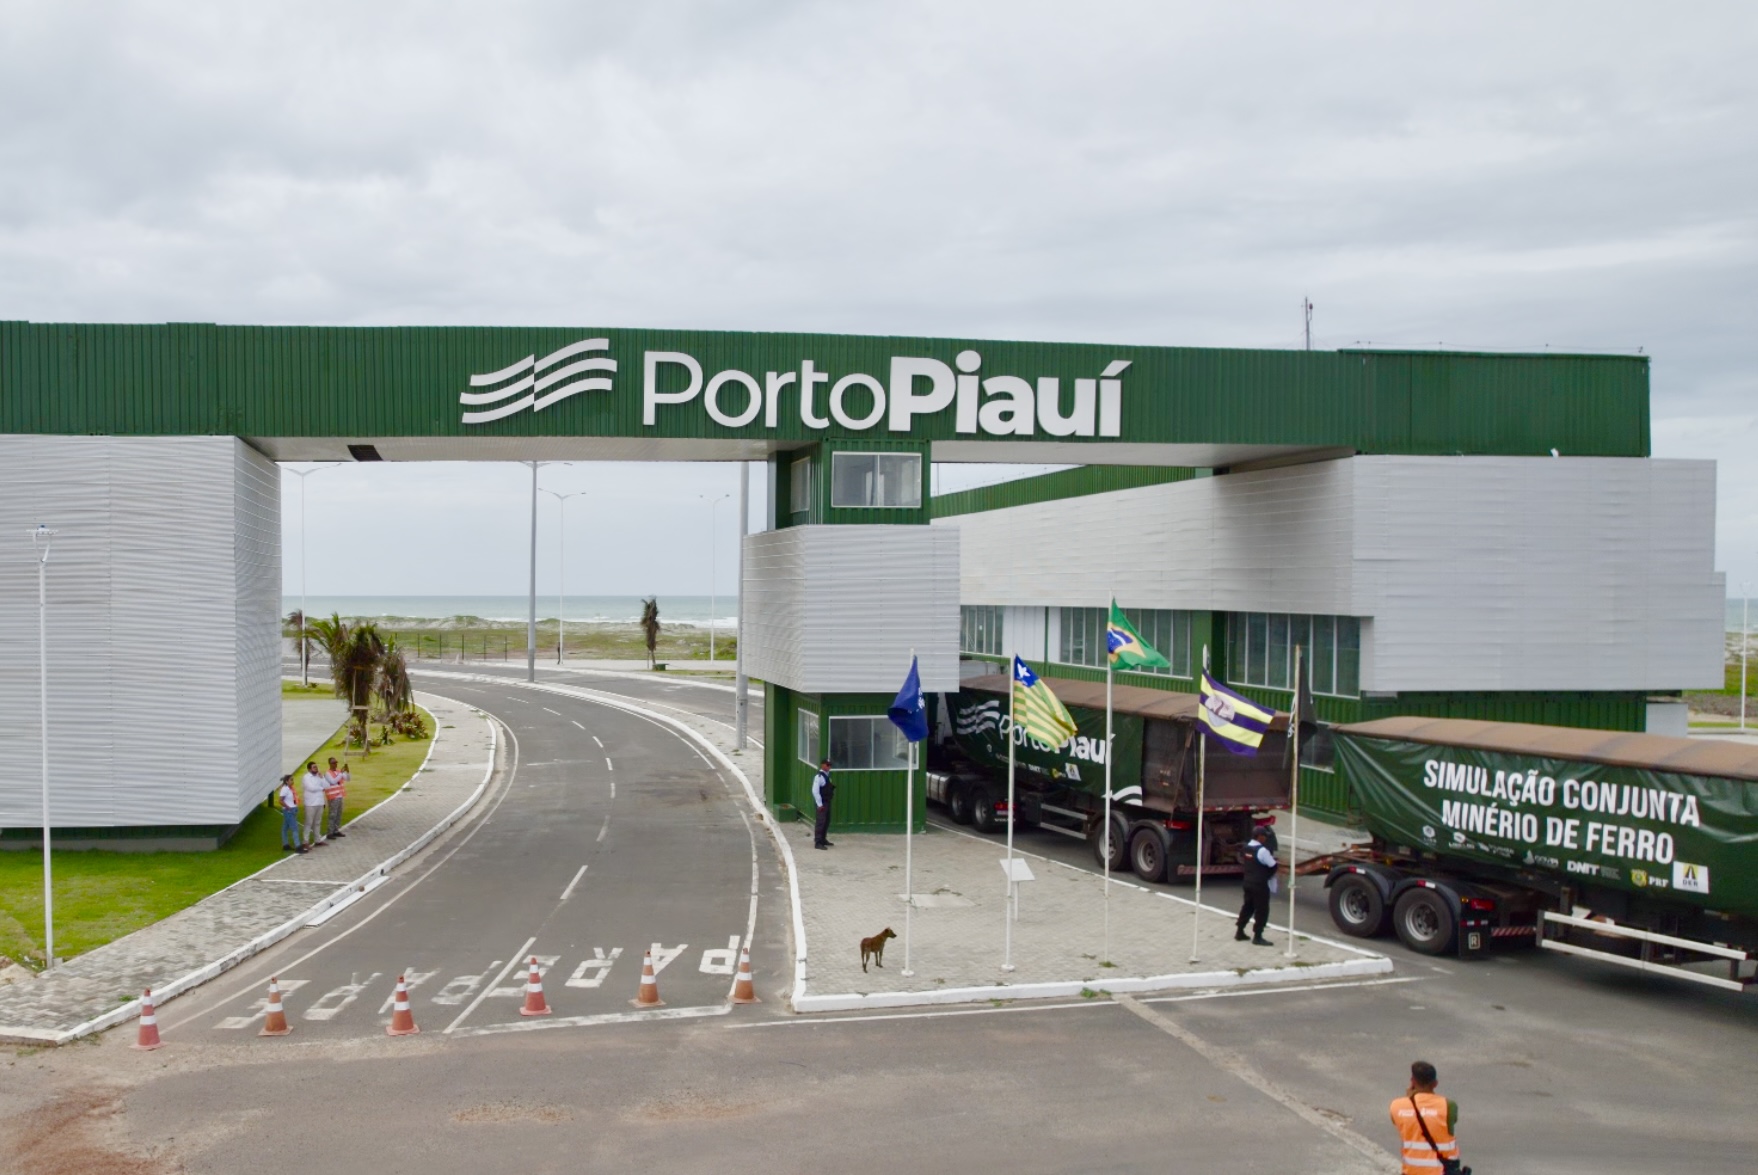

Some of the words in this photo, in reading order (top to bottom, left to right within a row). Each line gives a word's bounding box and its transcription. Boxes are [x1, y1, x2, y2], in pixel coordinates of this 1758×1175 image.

[642, 349, 1132, 438] PortoPiauí
[1423, 759, 1556, 807] SIMULAÇÃO
[1563, 778, 1700, 828] CONJUNTA
[1441, 800, 1538, 843] MINÉRIO
[1546, 816, 1580, 849] DE
[1586, 821, 1674, 864] FERRO
[1567, 860, 1599, 876] DNIT
[1649, 876, 1669, 888] PRF
